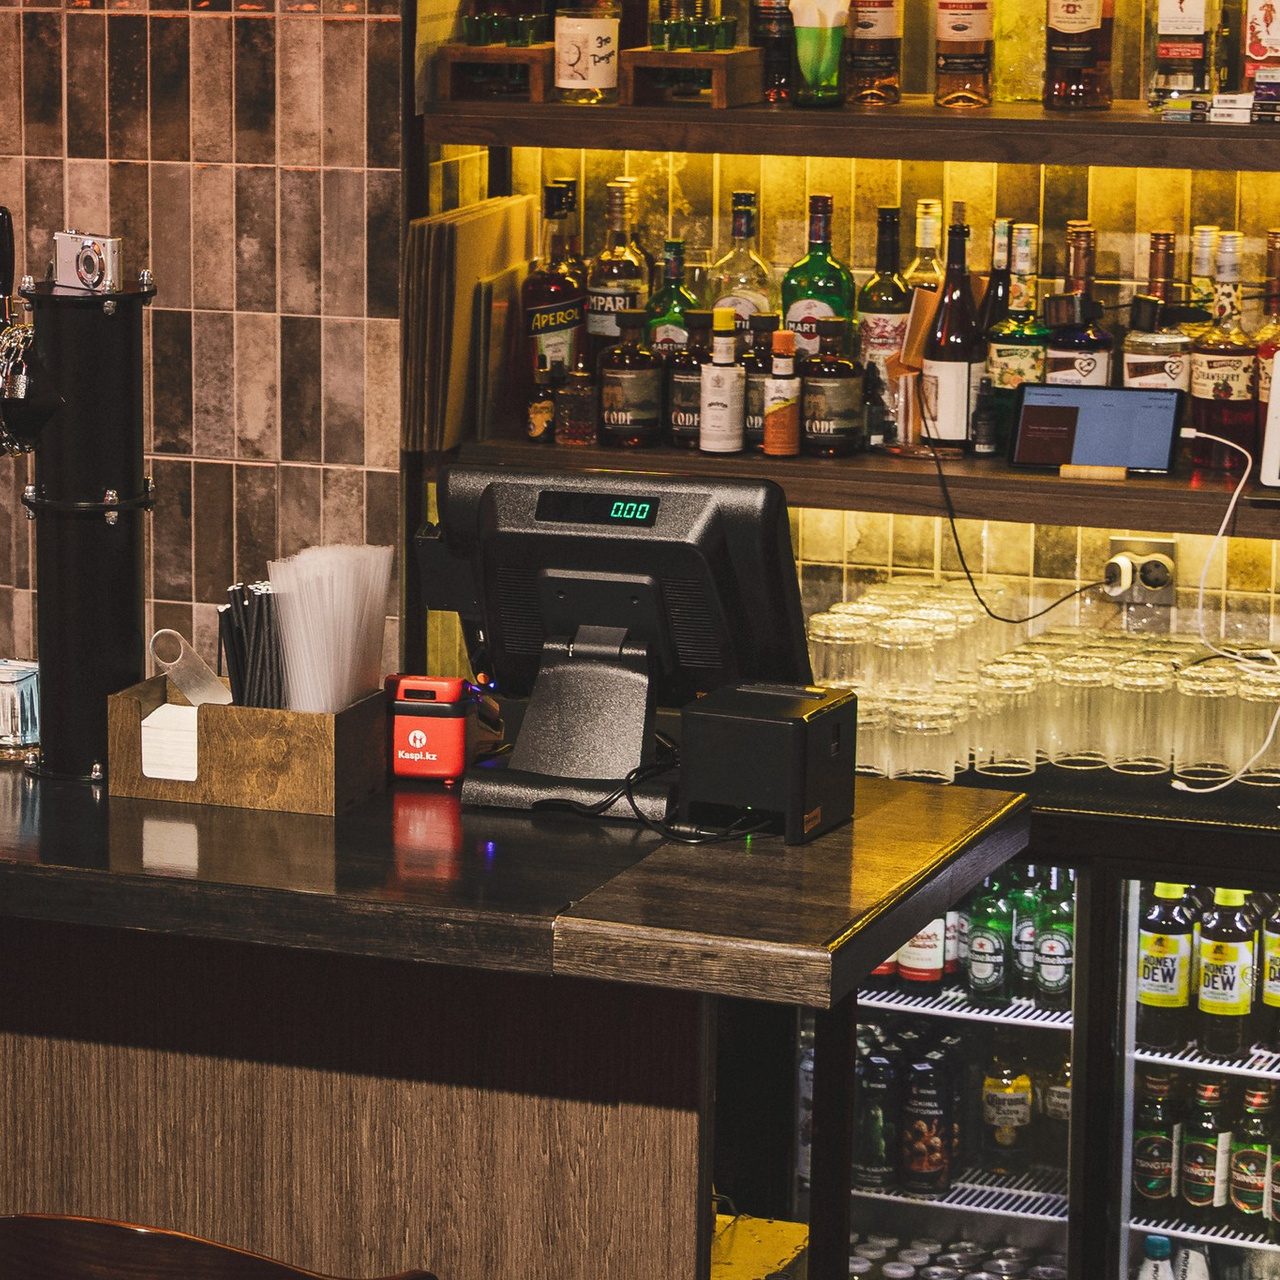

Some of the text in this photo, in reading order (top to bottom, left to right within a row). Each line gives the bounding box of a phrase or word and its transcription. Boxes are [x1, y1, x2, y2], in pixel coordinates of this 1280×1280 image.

[531, 308, 580, 331] APEROL
[788, 321, 818, 335] MART
[610, 501, 651, 520] 0.00
[397, 750, 438, 762] Kaspi.kz
[1142, 964, 1177, 984] DEW
[1203, 971, 1236, 991] DEW
